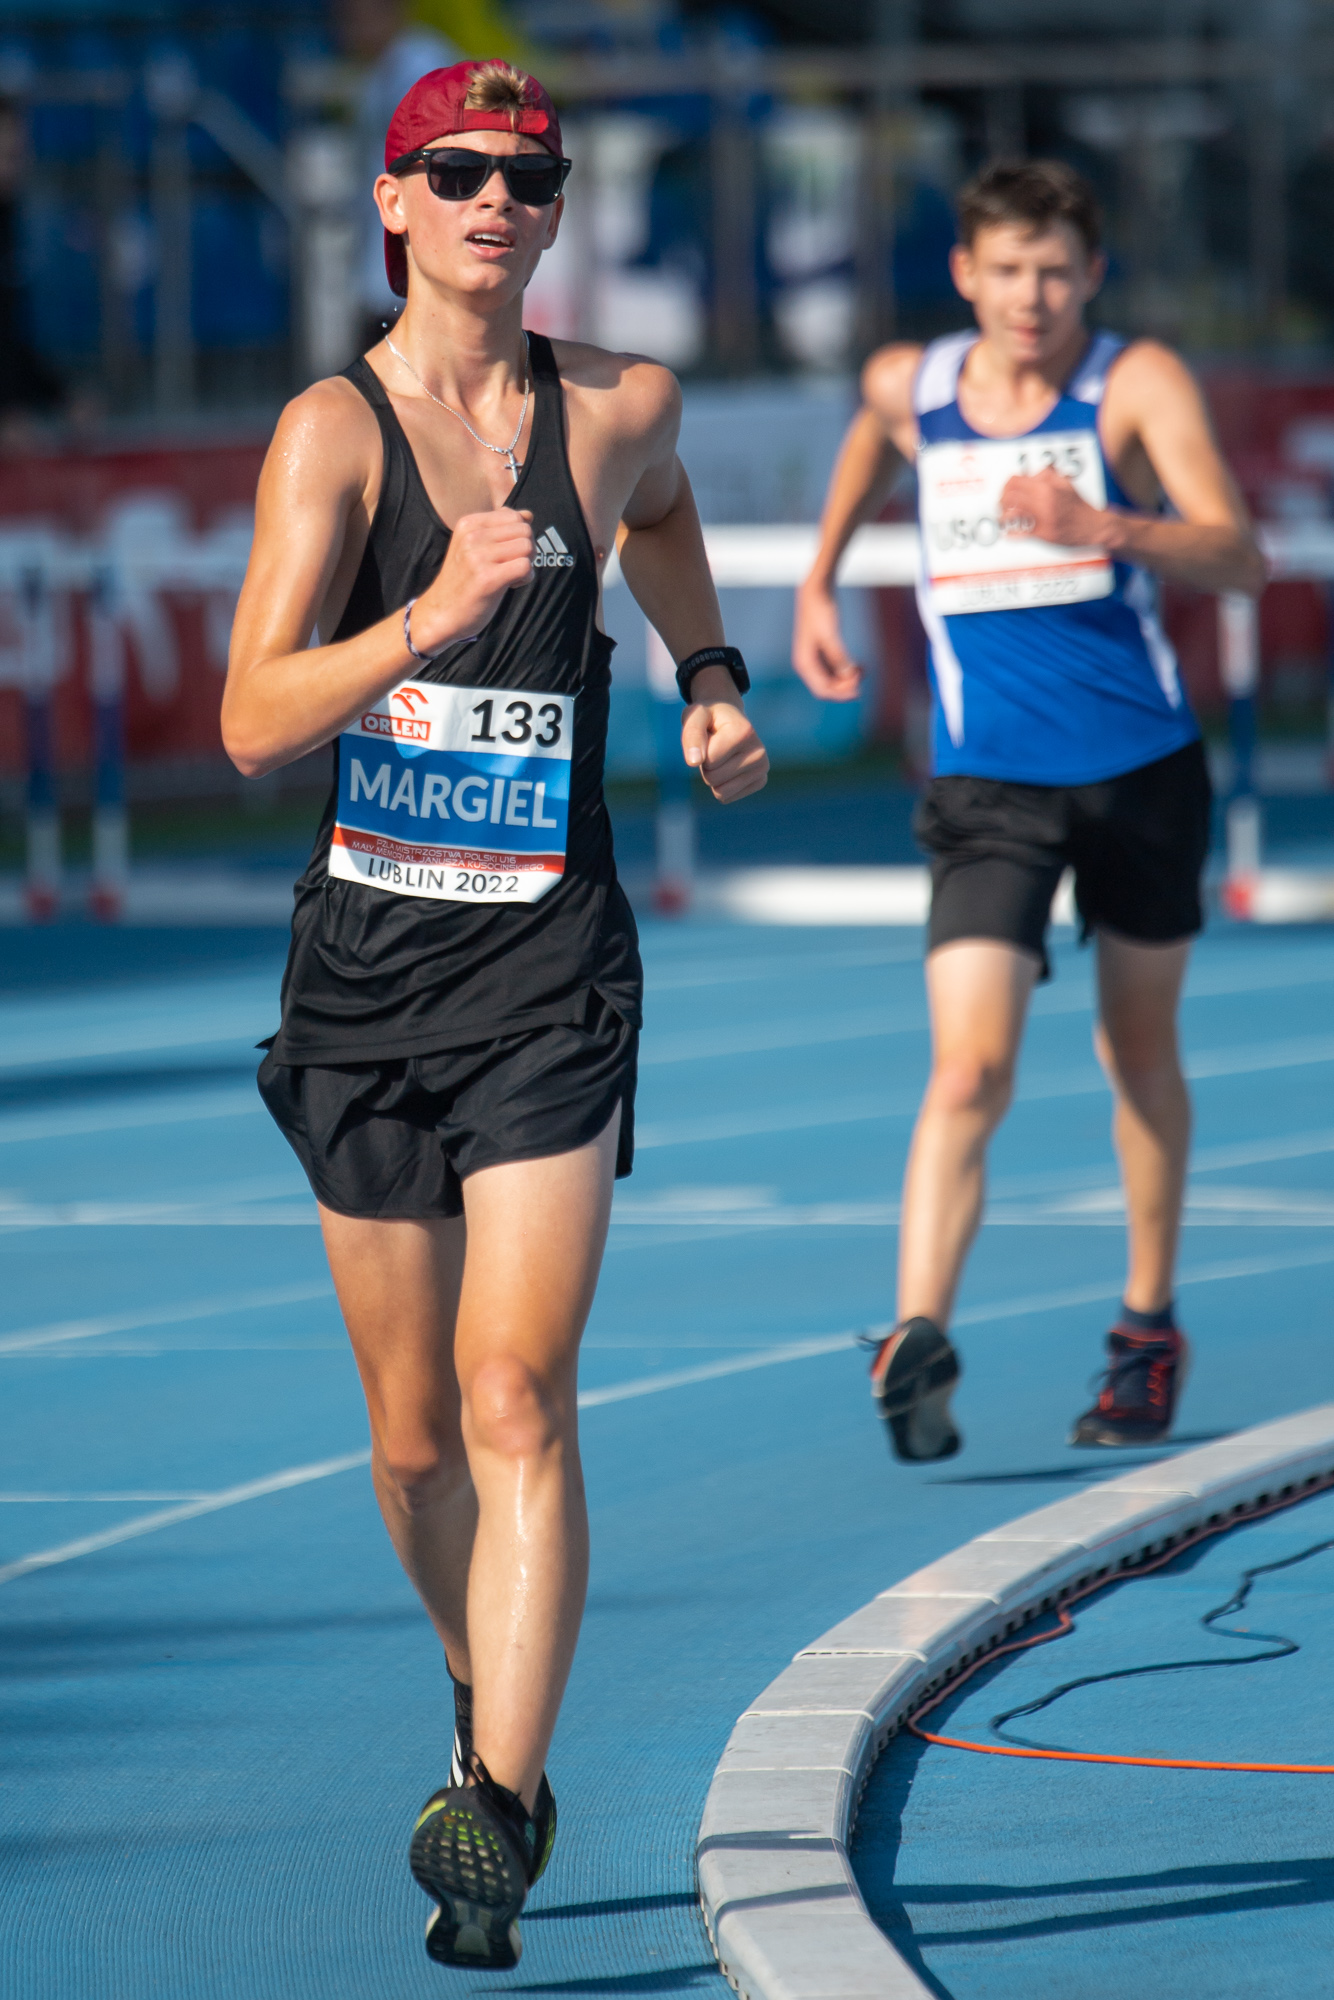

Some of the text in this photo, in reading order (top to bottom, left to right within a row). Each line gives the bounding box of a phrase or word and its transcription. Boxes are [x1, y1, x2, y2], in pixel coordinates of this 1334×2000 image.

[532, 552, 574, 567] didas
[364, 715, 428, 740] ORLEN
[471, 699, 563, 748] 133
[350, 758, 557, 828] MARGIEL
[376, 839, 517, 865] PZLA MISTRZOSTWA POLSKI U16
[419, 856, 466, 867] JANUSZA
[368, 858, 519, 894] LUBLIN 2022
